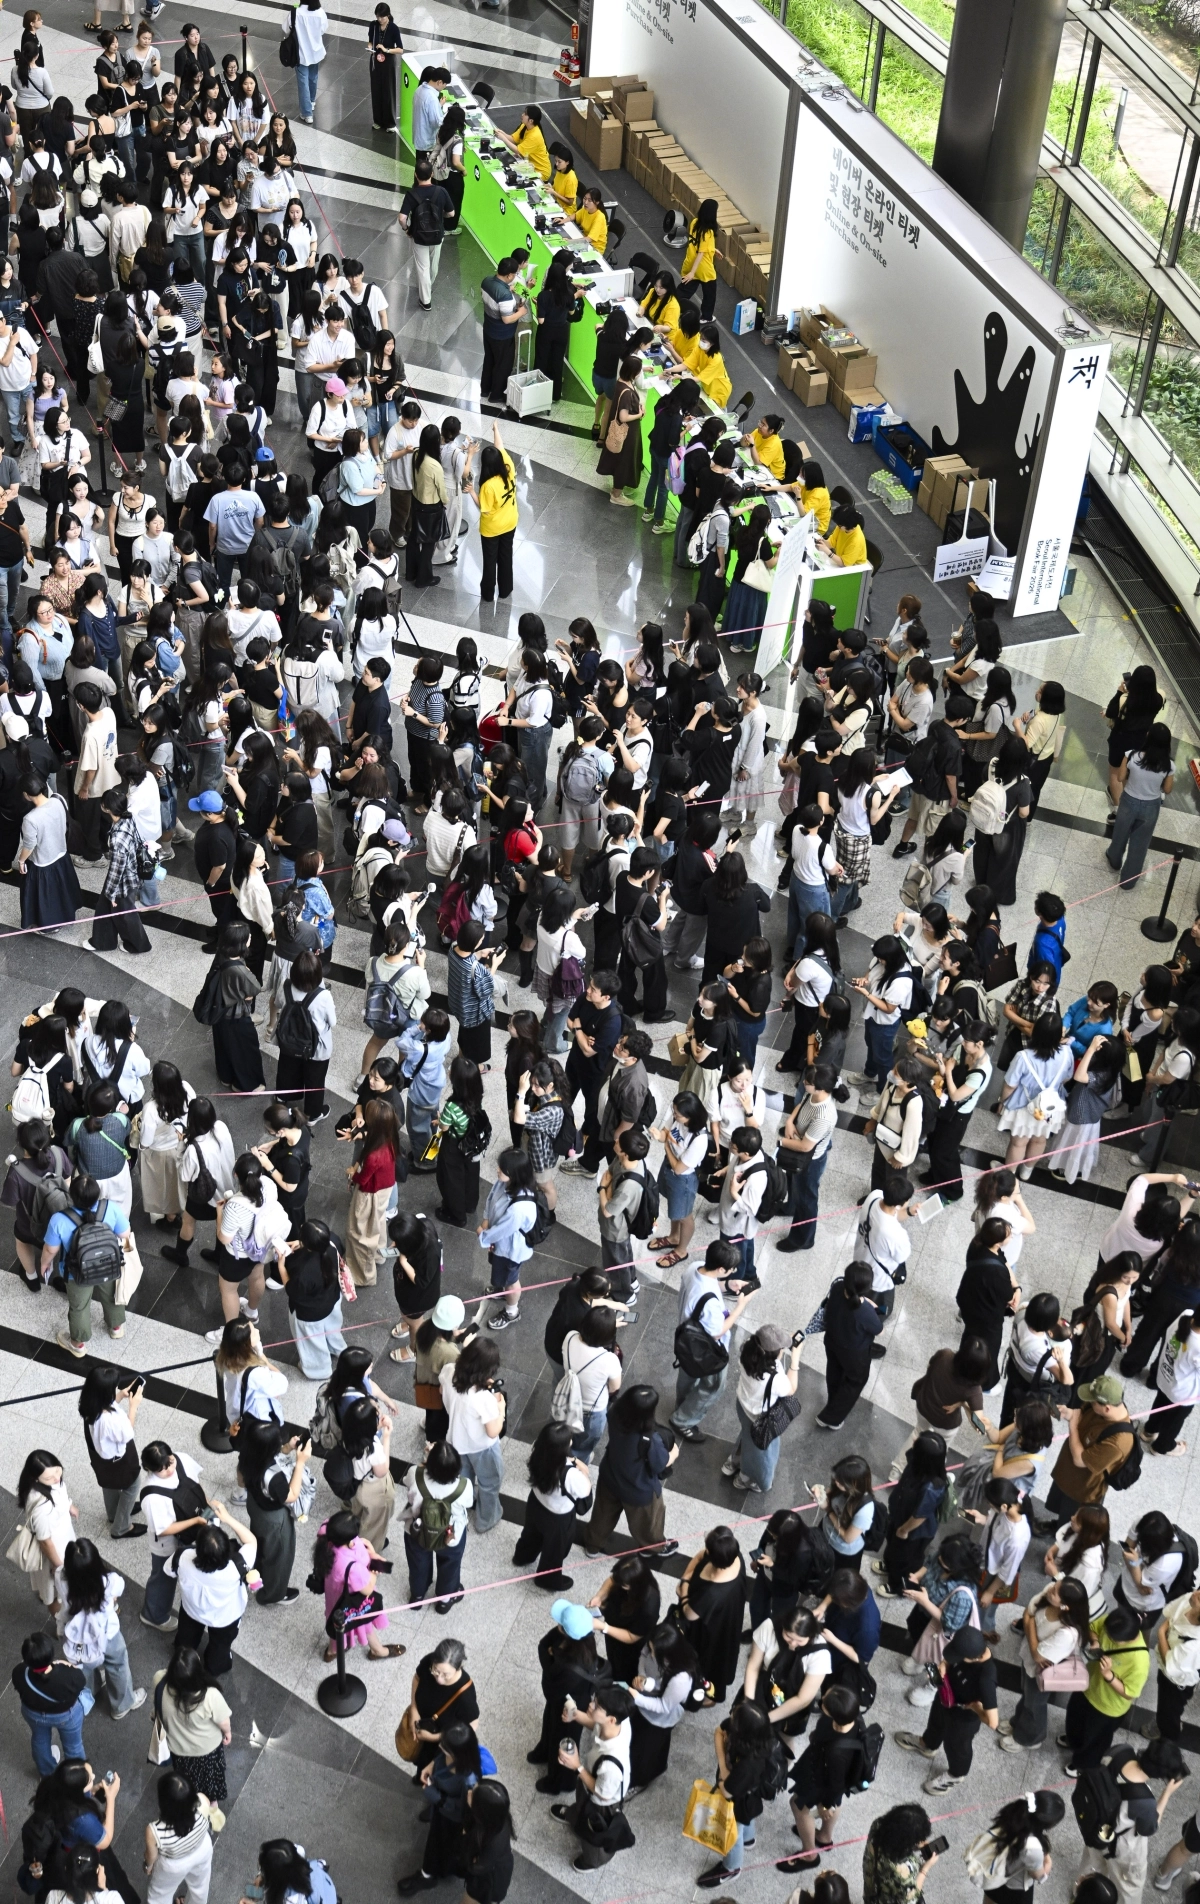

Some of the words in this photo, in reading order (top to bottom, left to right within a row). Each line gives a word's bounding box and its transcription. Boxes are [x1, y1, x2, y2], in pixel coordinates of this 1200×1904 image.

[626, 2, 653, 36] Purchase
[652, 16, 674, 44] On-site
[829, 171, 839, 198] 및
[841, 184, 861, 218] 현장
[863, 207, 884, 243] 티켓
[833, 147, 862, 191] 네이버
[864, 179, 895, 225] 온라인
[898, 212, 920, 249] 티켓
[824, 210, 859, 254] Purchase
[825, 198, 851, 229] Online
[851, 225, 859, 239] &
[860, 232, 887, 268] On-site
[1032, 560, 1040, 574] Fair
[1035, 540, 1044, 560] Book
[1042, 539, 1052, 559] Seoul
[1045, 538, 1061, 589] 서울국제도서전
[1033, 558, 1048, 605] International
[671, 1126, 684, 1142] NIKE
